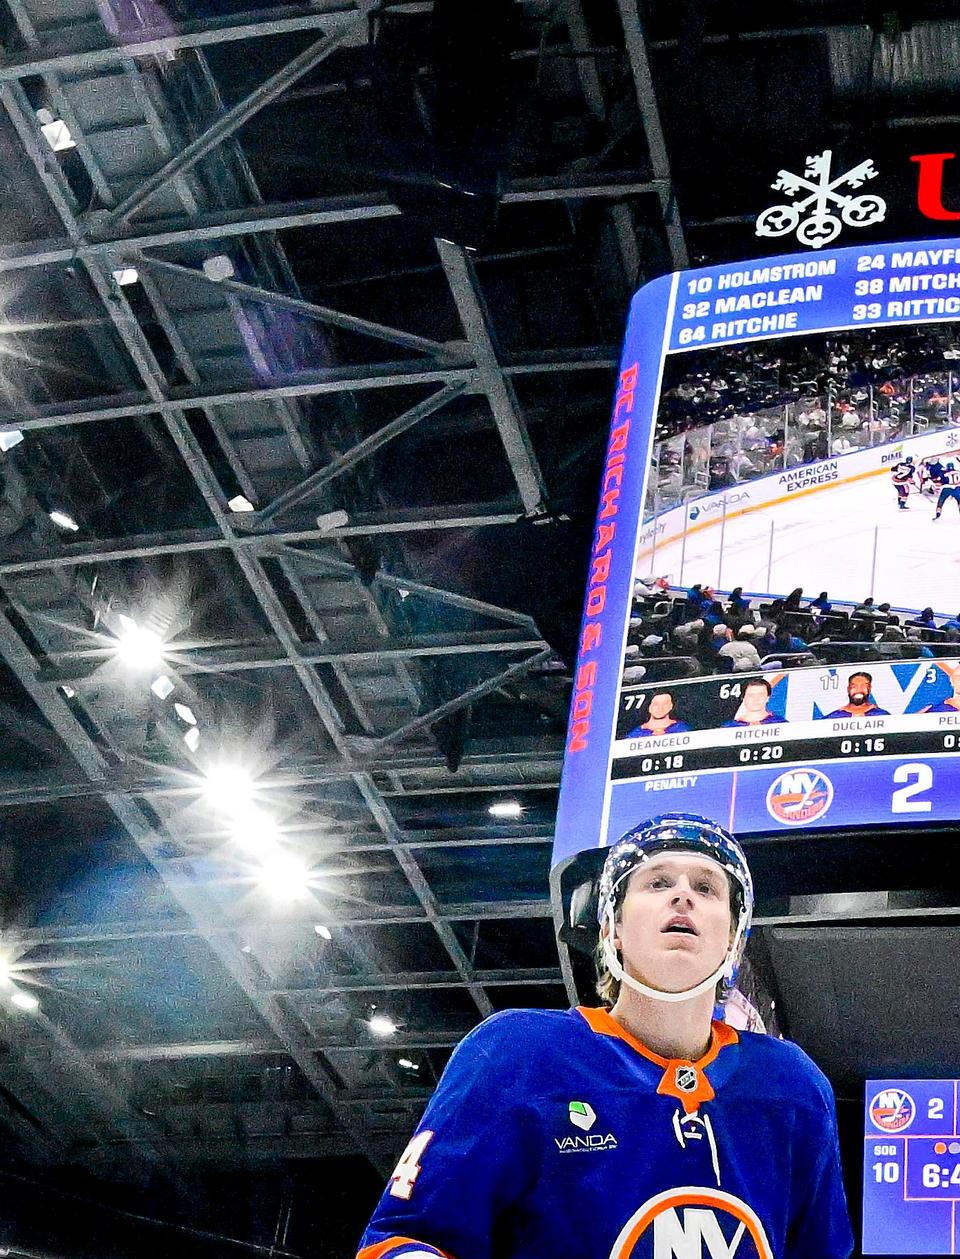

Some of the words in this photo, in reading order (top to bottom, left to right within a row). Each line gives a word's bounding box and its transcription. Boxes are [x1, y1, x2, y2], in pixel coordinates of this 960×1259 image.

[857, 254, 887, 274] 24
[687, 276, 712, 296] 10
[717, 260, 836, 291] HOLMSTROM
[854, 278, 885, 297] 38
[682, 301, 711, 321] 32
[714, 285, 823, 315] MACLEAN
[853, 303, 882, 321] 33
[678, 326, 707, 346] 64
[710, 313, 798, 341] RITCHIE
[779, 461, 839, 485] AMERICAN
[787, 471, 839, 493] EXPRESS
[585, 420, 630, 618] RICHARD
[820, 674, 840, 691] 11
[925, 667, 937, 684] 3
[719, 683, 742, 700] 64
[568, 659, 597, 753] SON
[624, 694, 646, 711] 77
[735, 726, 781, 741] RITCHIE
[832, 718, 886, 733] DUCLAIR
[629, 735, 691, 752] DEANGELO
[841, 737, 886, 755] 0:16
[739, 744, 784, 763] 0:20
[641, 755, 684, 773] 0:18
[644, 774, 698, 793] PENALTY
[780, 768, 824, 797] NY
[890, 762, 935, 814] 2
[927, 1099, 944, 1120] 2
[554, 1132, 618, 1150] VANDA
[389, 1129, 434, 1200] 4
[872, 1162, 899, 1183] 10
